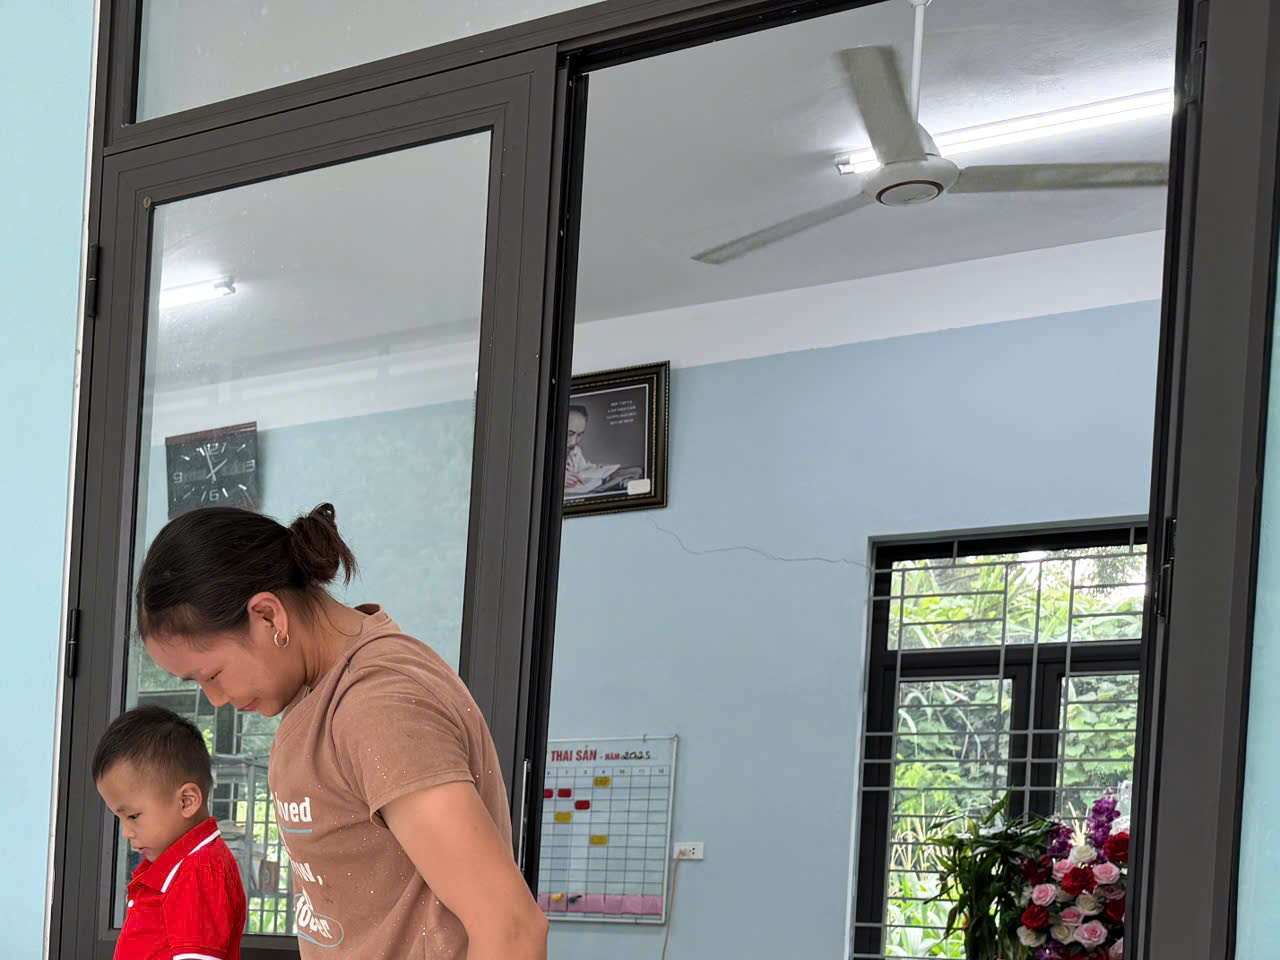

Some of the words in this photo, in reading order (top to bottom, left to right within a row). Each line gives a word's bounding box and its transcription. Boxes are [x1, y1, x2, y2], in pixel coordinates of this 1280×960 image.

[173, 471, 183, 484] 9
[209, 488, 219, 501] 6
[551, 750, 573, 762] THAI
[575, 745, 597, 761] SẢN
